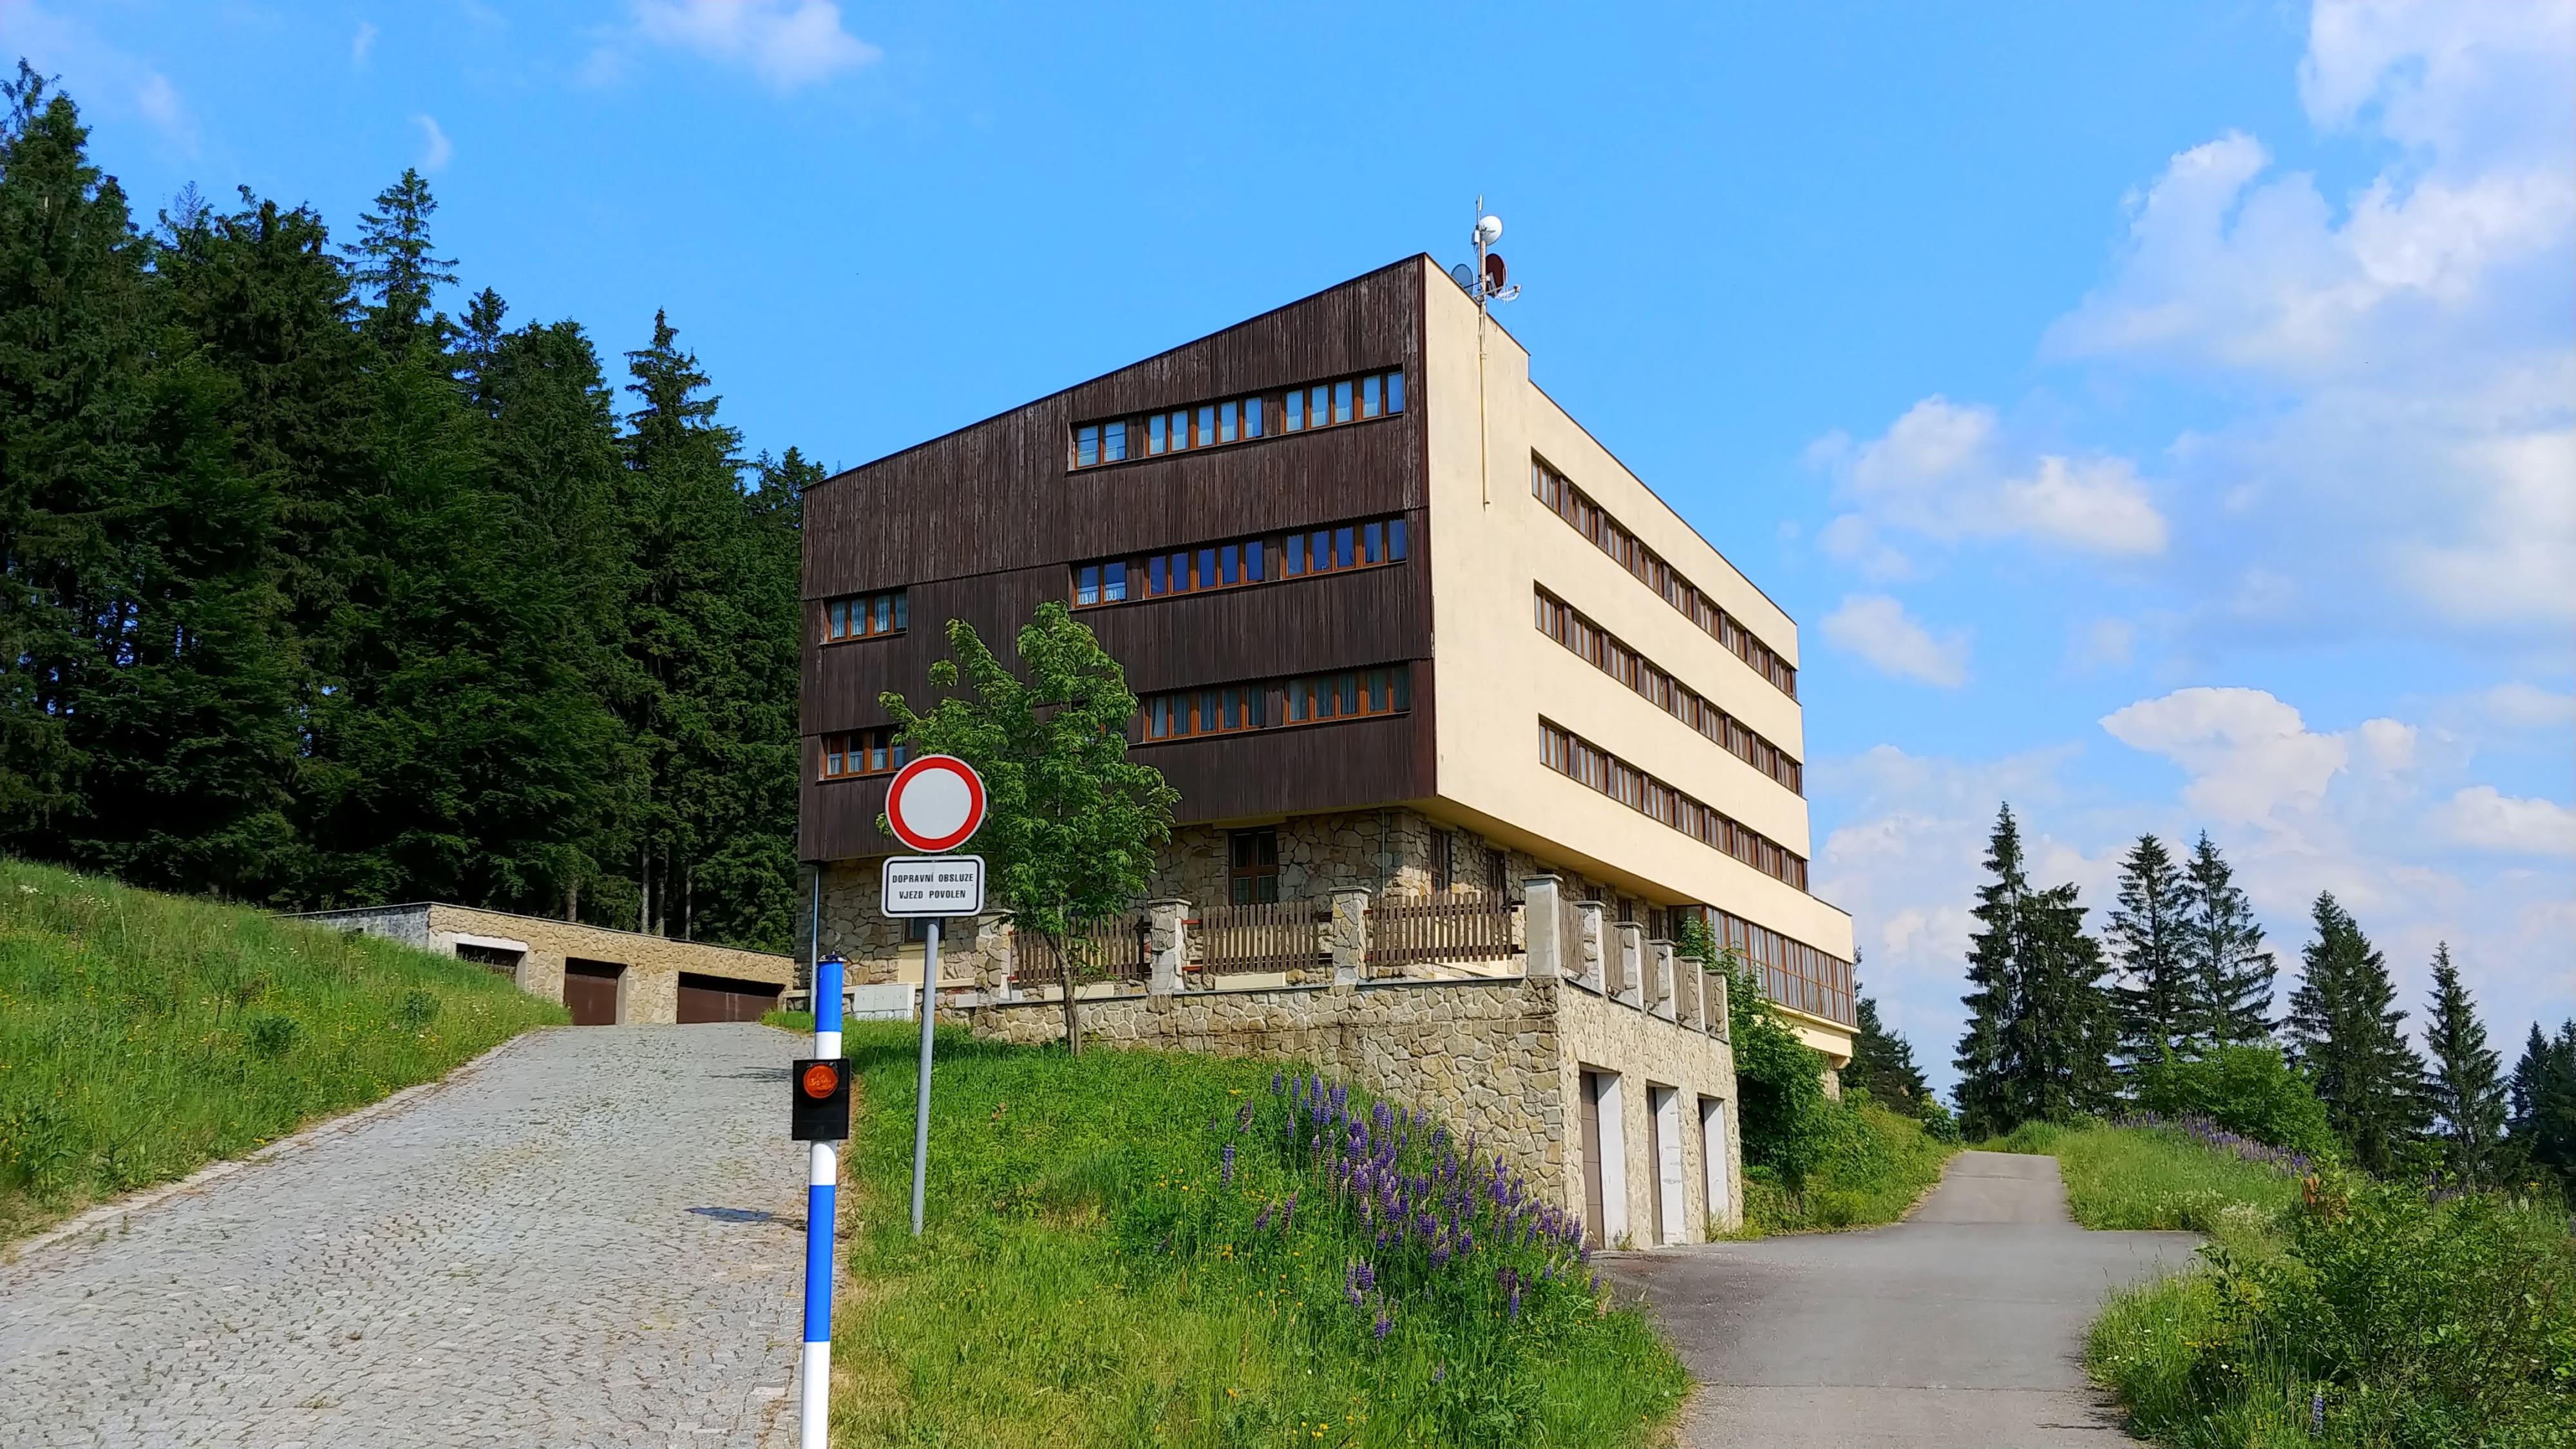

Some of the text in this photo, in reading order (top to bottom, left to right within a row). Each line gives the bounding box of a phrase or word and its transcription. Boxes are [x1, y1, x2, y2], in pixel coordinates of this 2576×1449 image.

[893, 872, 973, 883] DOPRAVNÍ OBSLUZE
[899, 890, 966, 899] VJEZD POVOLEN
